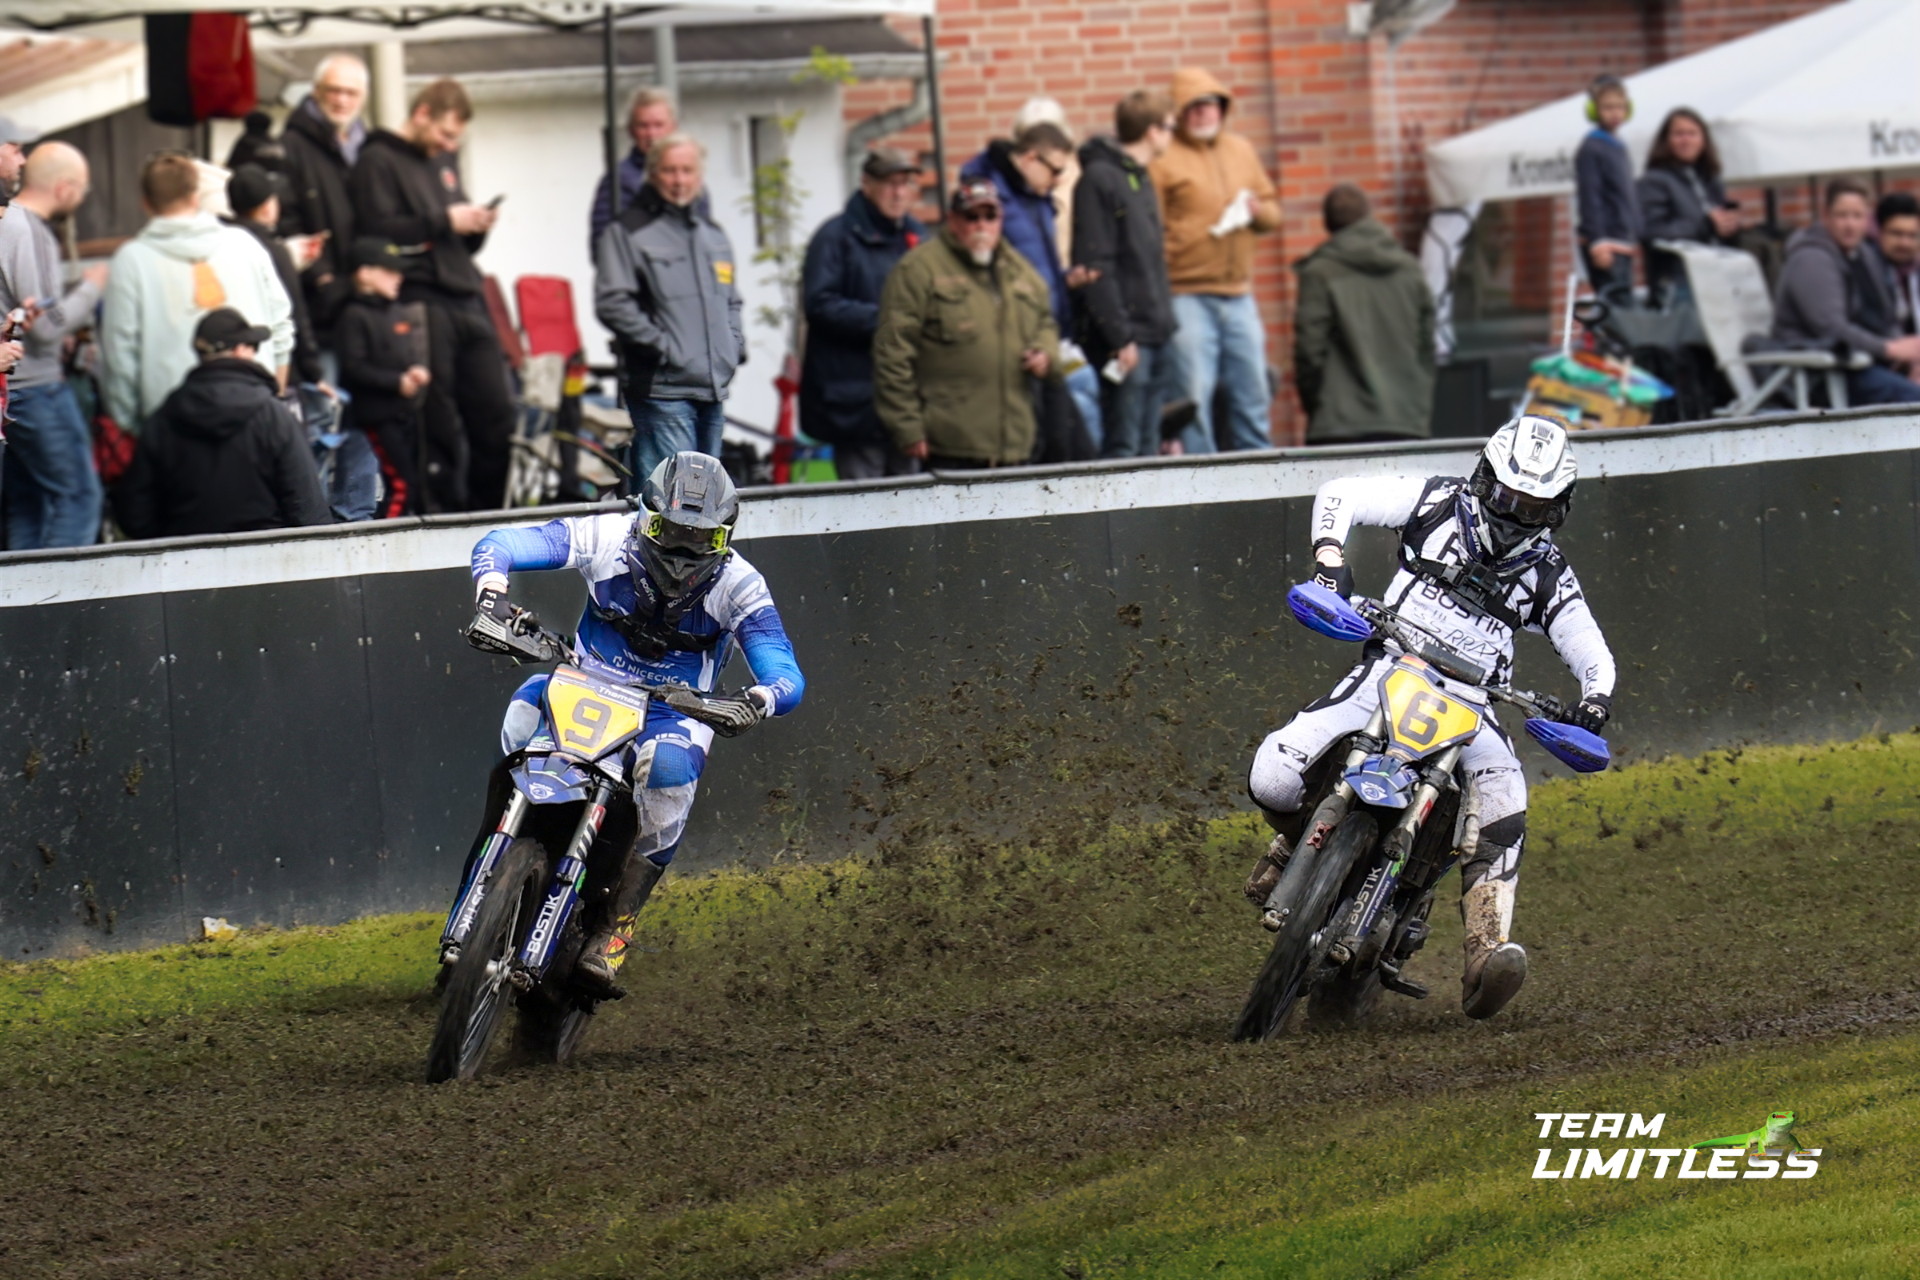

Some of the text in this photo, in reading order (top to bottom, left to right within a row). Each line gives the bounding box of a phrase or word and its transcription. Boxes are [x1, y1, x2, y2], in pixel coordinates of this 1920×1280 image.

[1320, 496, 1342, 531] FXR
[482, 591, 498, 615] FO
[627, 665, 679, 684] NICECNC
[564, 698, 613, 749] 9
[1398, 690, 1448, 746] 6
[1350, 867, 1382, 925] BOSTIK
[526, 893, 561, 954] BOSTIK
